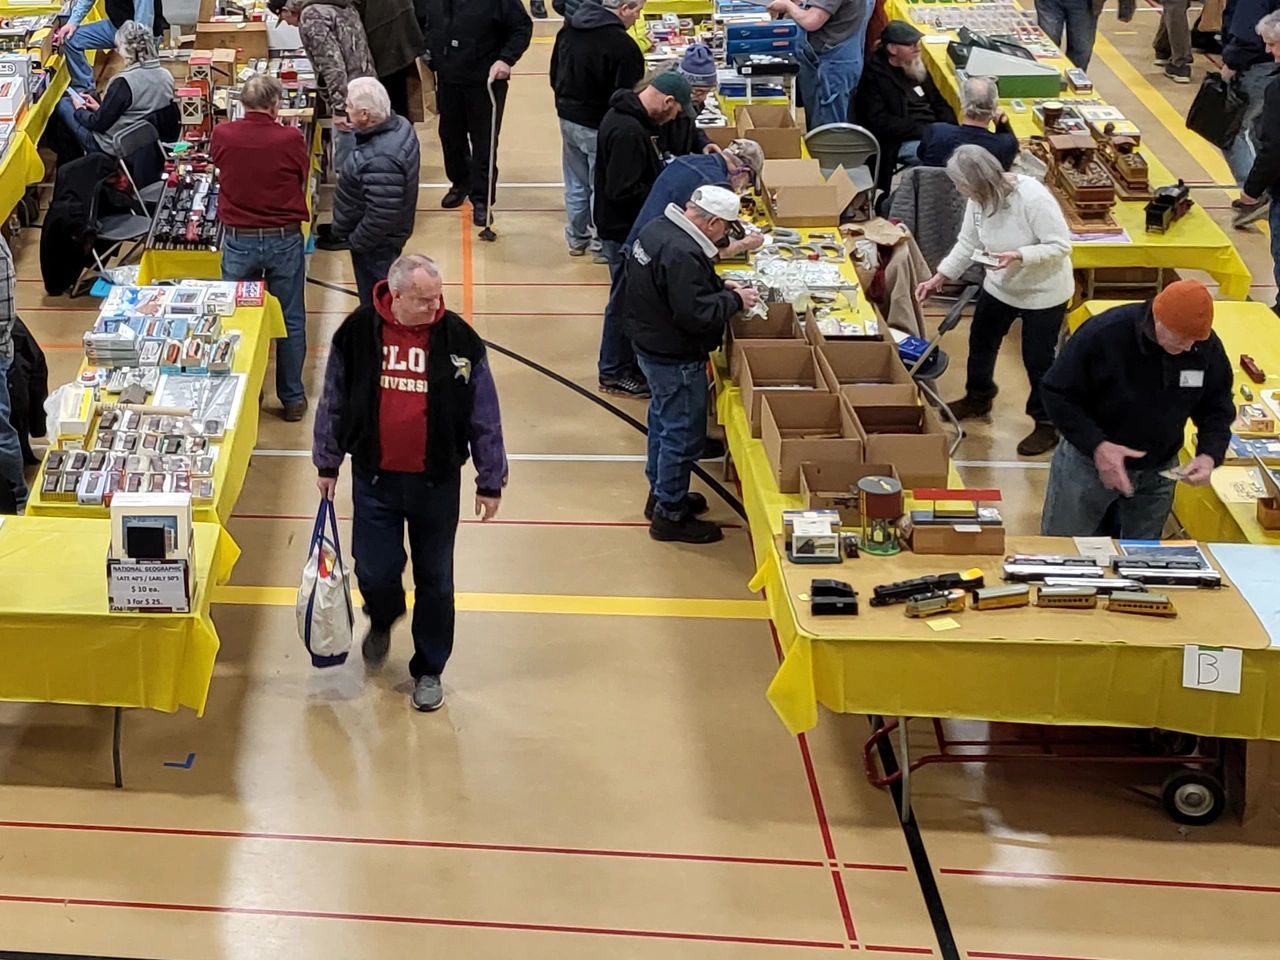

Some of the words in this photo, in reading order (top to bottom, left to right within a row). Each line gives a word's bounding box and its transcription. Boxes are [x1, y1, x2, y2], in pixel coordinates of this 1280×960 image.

[131, 585, 136, 593] $
[145, 597, 150, 605] $
[1197, 652, 1220, 686] B
